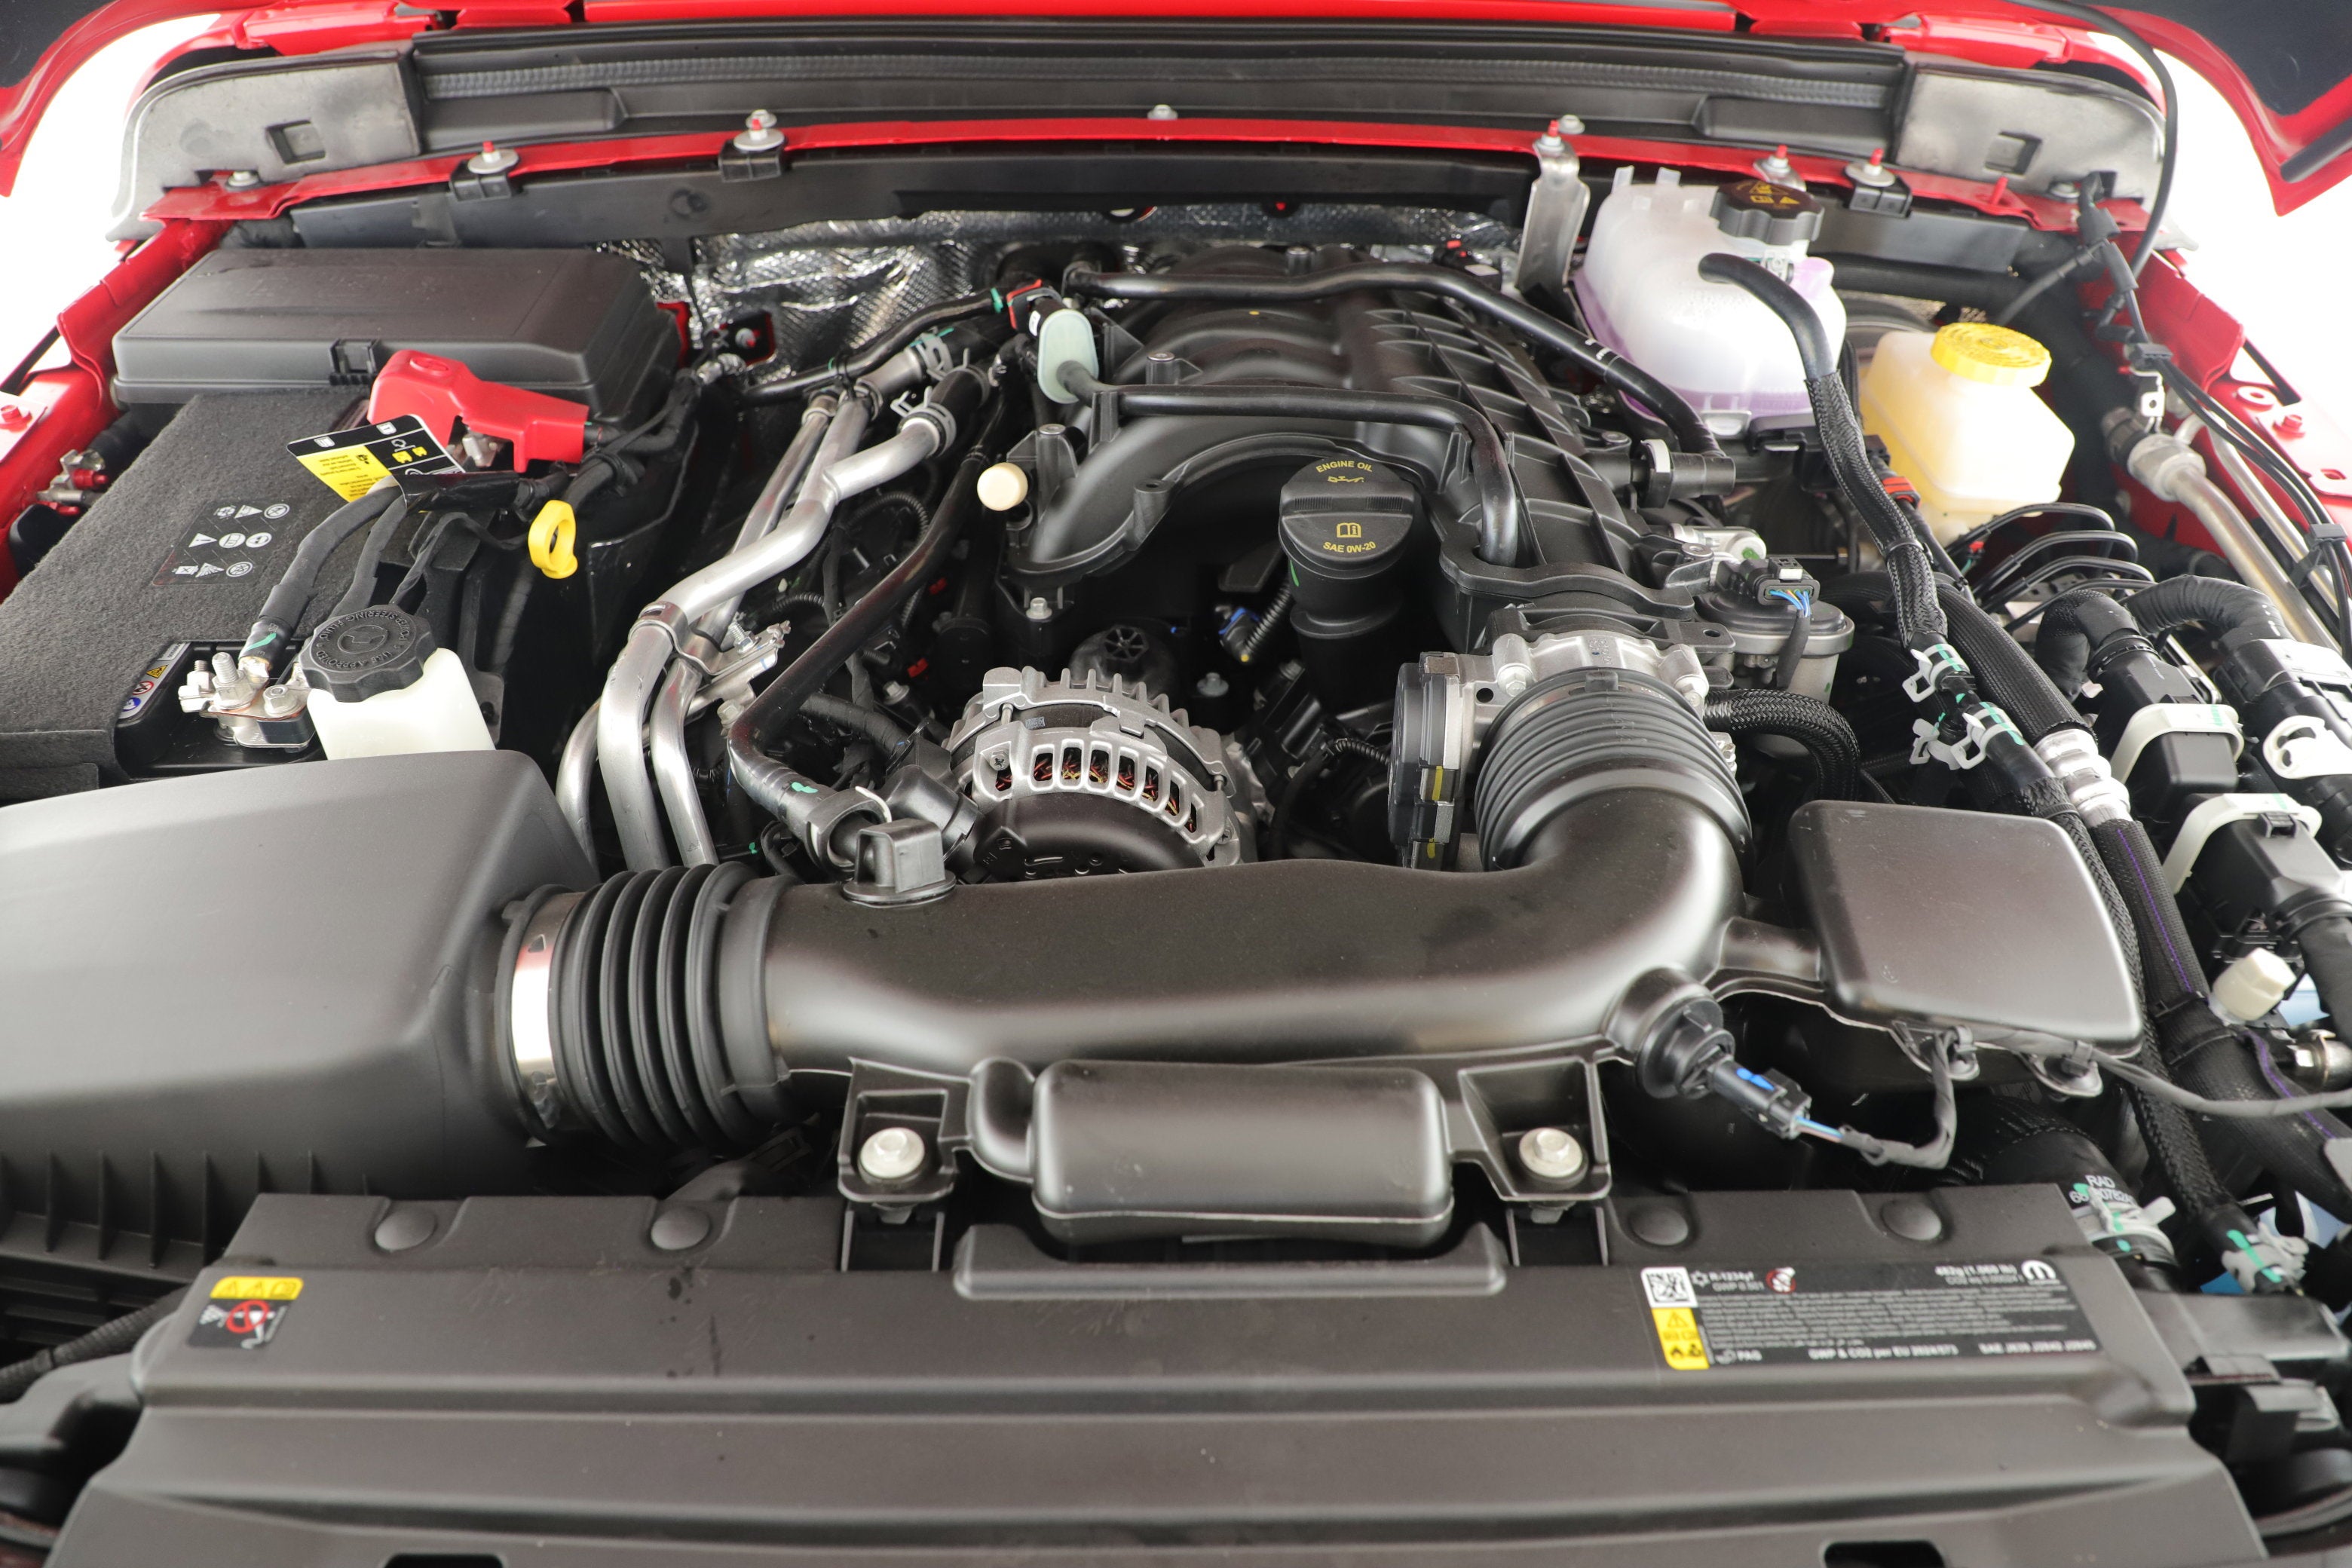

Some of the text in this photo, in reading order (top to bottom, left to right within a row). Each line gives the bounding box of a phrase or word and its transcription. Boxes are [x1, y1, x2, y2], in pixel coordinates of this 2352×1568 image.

[1316, 461, 1373, 473] ENGINE OIL
[1323, 541, 1377, 553] SAE 0W-20
[319, 609, 411, 642] POWER STEERING FLUID
[316, 651, 366, 668] APPROVED
[2084, 1174, 2116, 1189] RAD
